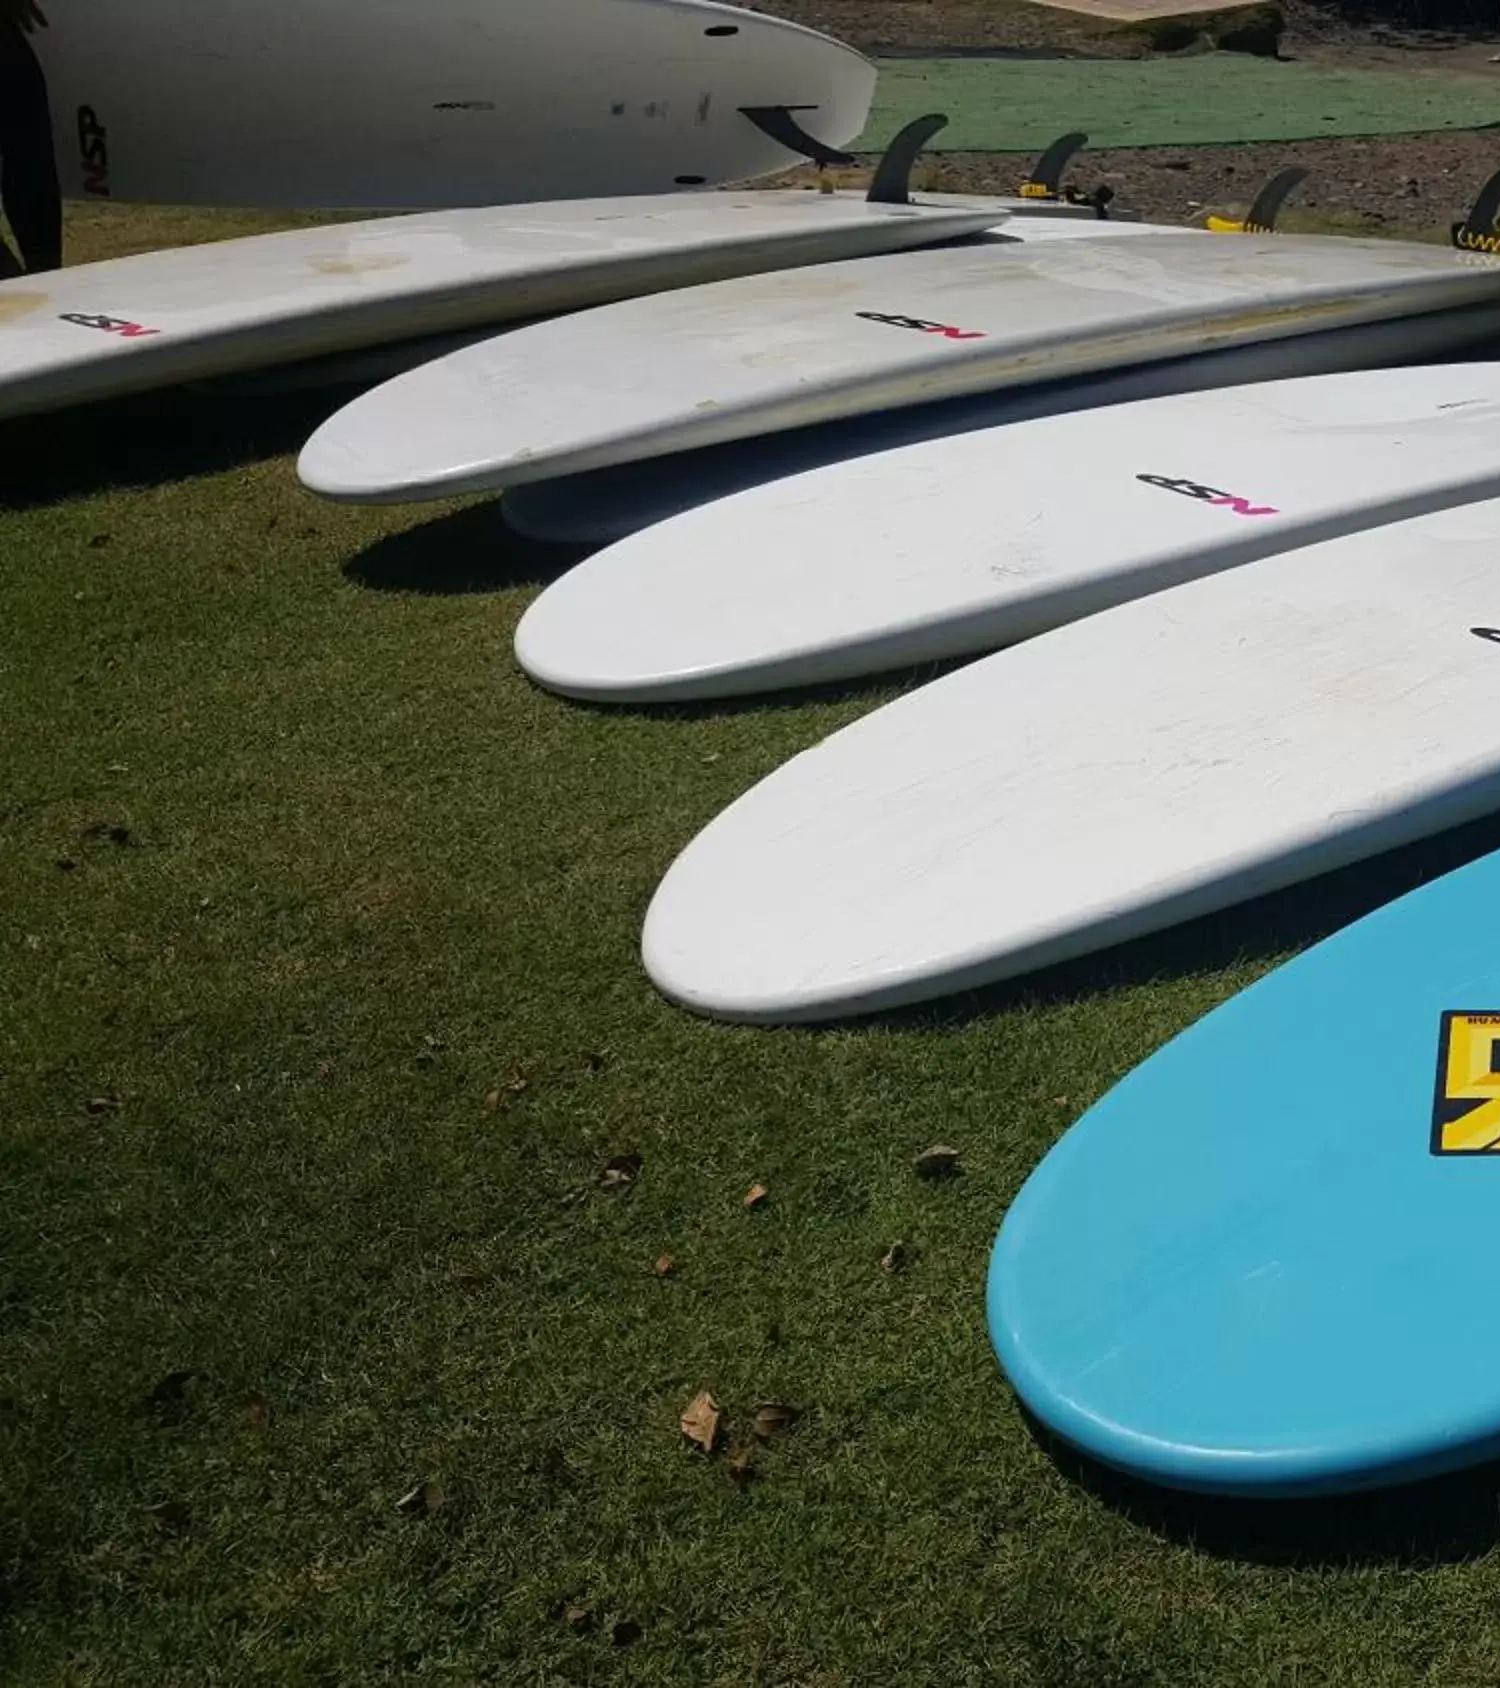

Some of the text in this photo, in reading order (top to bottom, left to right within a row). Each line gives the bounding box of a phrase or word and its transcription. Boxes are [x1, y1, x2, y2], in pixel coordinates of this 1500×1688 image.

[77, 105, 109, 196] NSP
[58, 313, 161, 336] NSP
[855, 312, 987, 338] NSP
[1136, 474, 1280, 515] NSP
